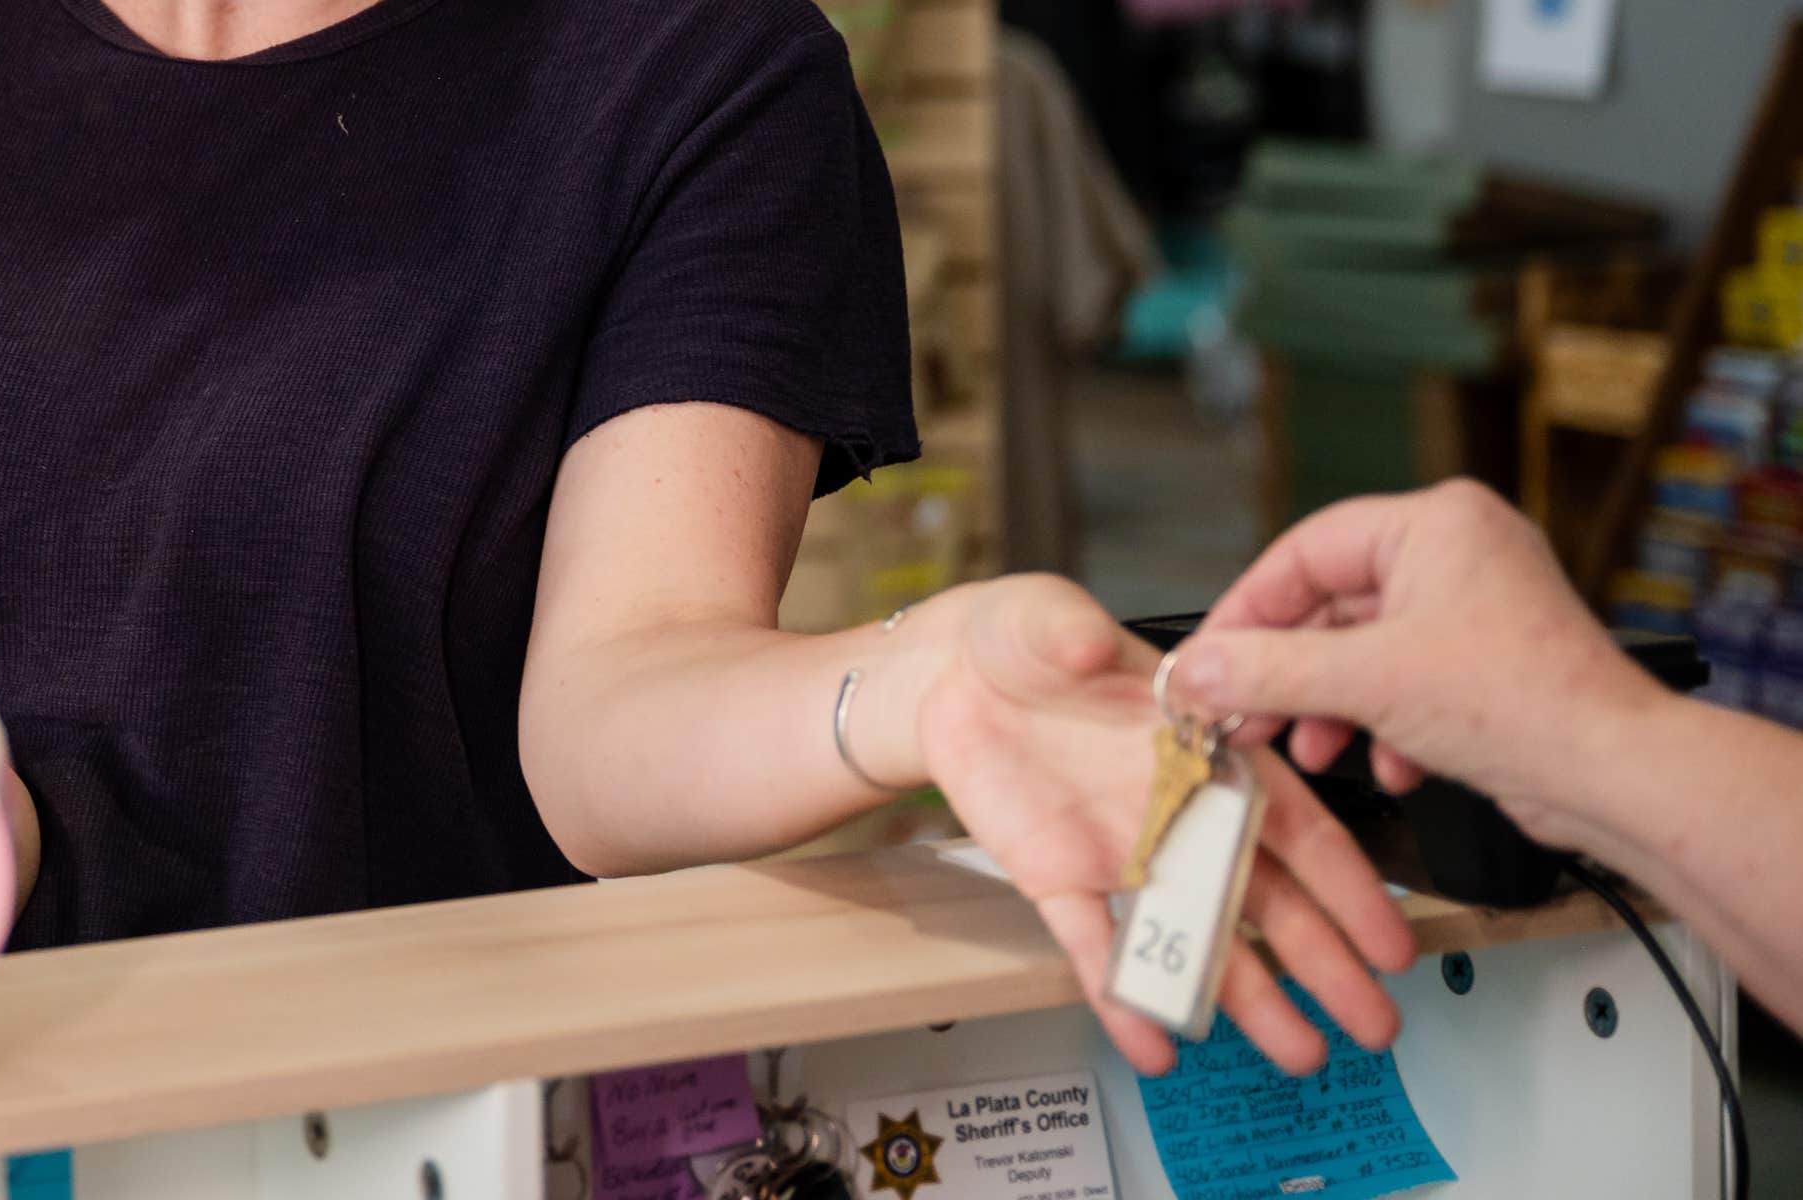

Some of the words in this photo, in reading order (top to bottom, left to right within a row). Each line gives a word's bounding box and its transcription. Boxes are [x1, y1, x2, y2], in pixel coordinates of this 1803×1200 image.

[1135, 916, 1190, 976] 26
[947, 1100, 971, 1119] La
[975, 1095, 1021, 1115] Plata
[1025, 1086, 1089, 1108] County
[955, 1116, 1032, 1143] Sheriff's
[1036, 1111, 1090, 1132] Office
[1007, 1167, 1051, 1183] Deputy
